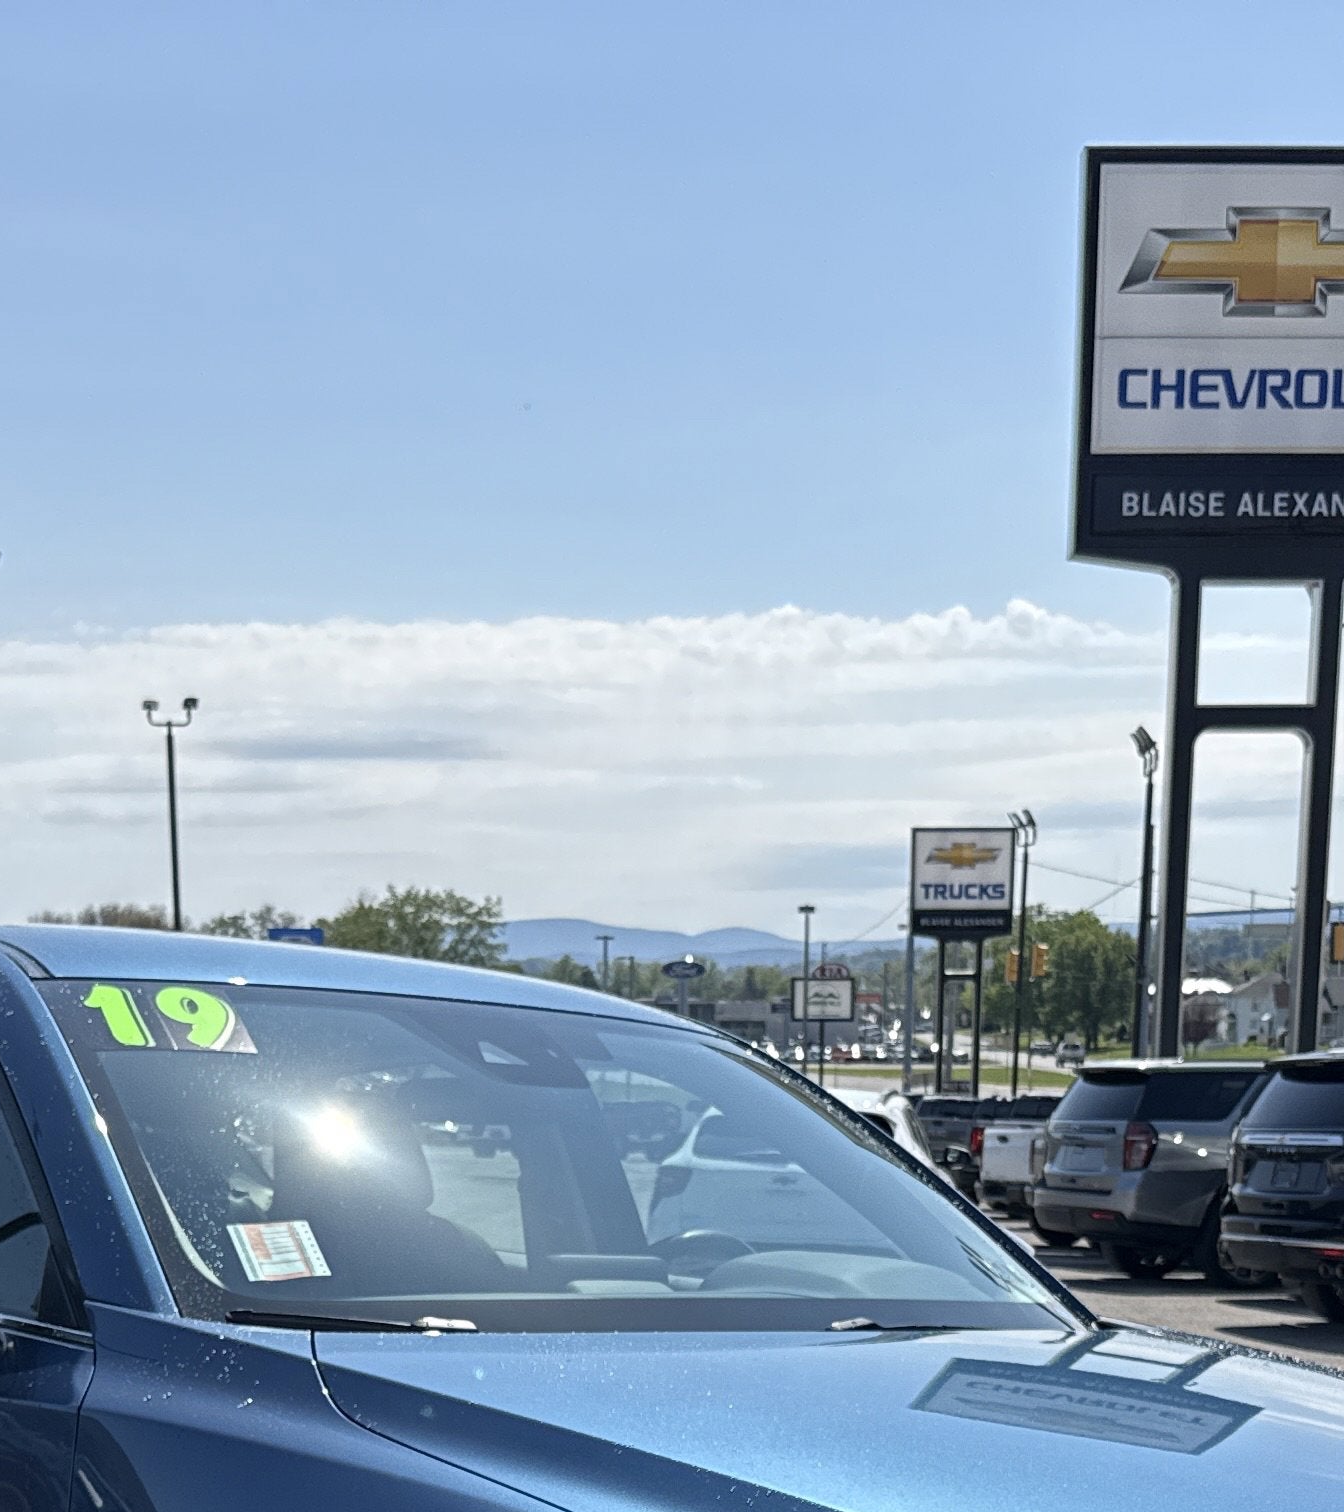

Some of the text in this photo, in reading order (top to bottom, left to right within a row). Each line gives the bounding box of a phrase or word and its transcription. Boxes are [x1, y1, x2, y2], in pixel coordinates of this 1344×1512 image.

[1121, 492, 1225, 517] BLAISE
[920, 882, 1005, 901] TRUCKS
[84, 984, 236, 1050] 19
